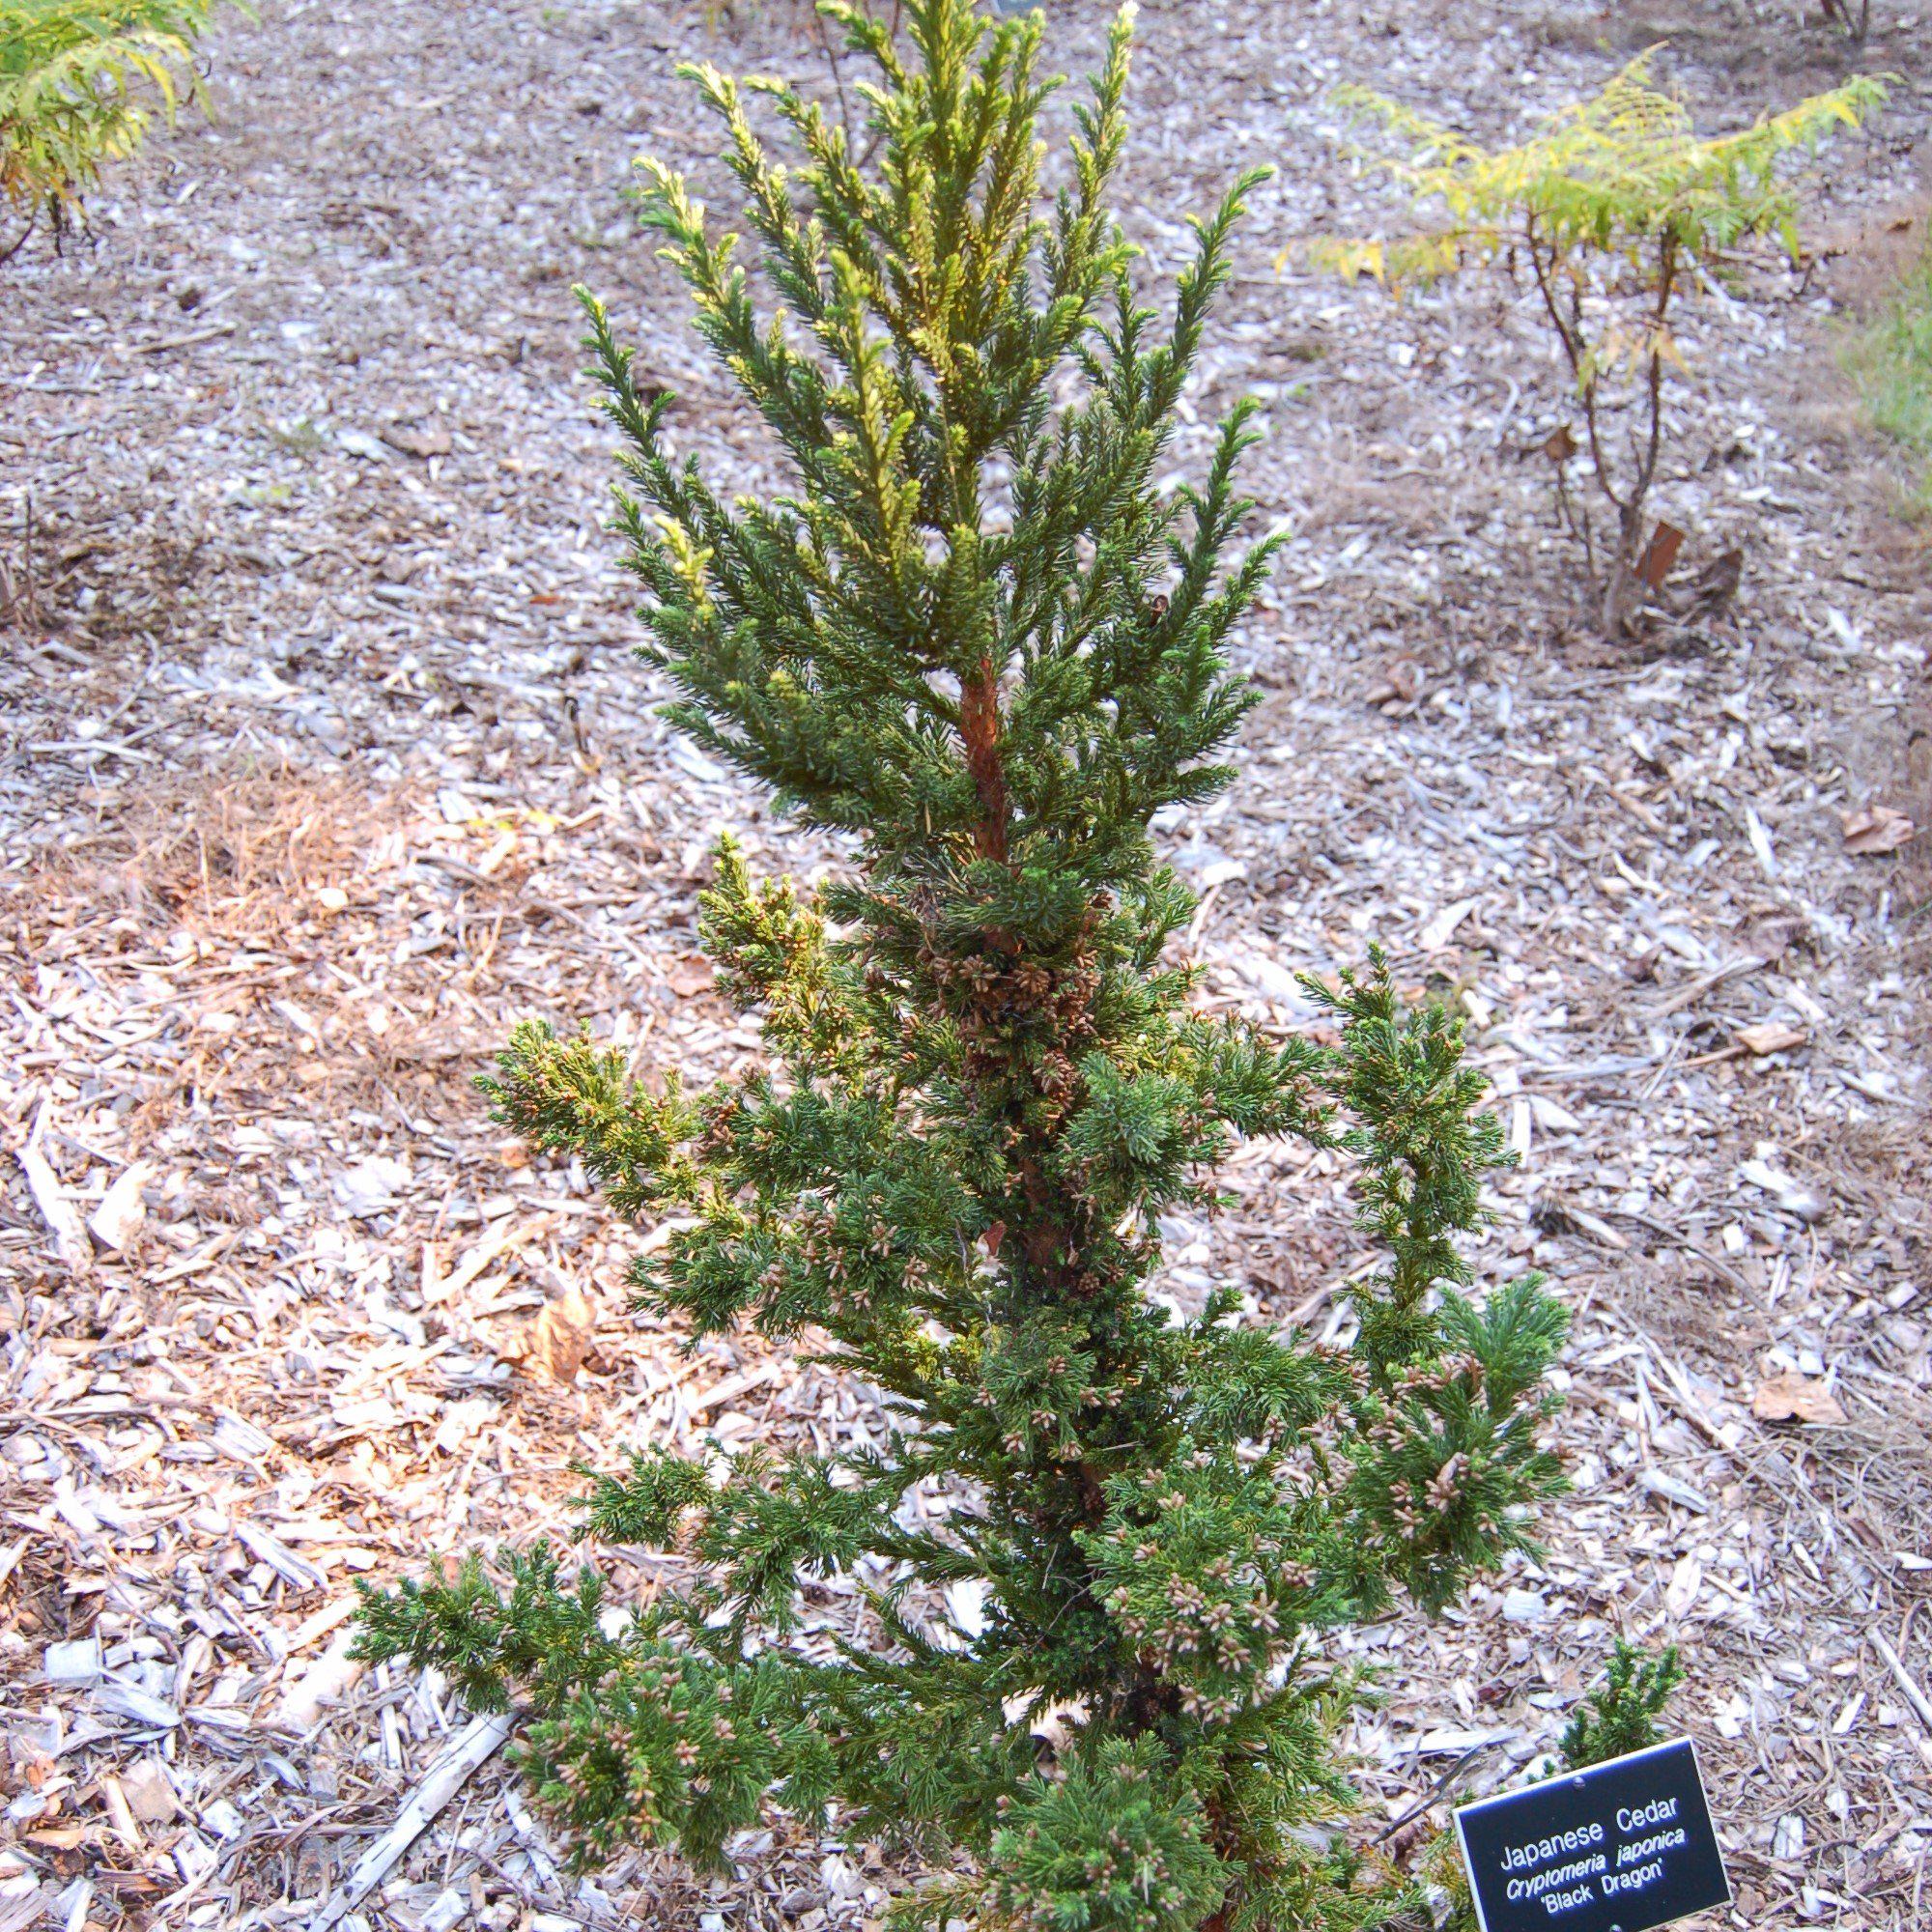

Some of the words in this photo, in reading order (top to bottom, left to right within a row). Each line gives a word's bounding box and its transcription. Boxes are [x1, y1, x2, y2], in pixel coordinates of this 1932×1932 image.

[1500, 1822, 1604, 1871] Japanese
[1616, 1797, 1677, 1832] Cedar
[1506, 1854, 1606, 1900] Cryptomeria
[1616, 1828, 1686, 1867] japonica
[1541, 1885, 1594, 1914] 'Black
[1601, 1857, 1663, 1895] Dragon'
